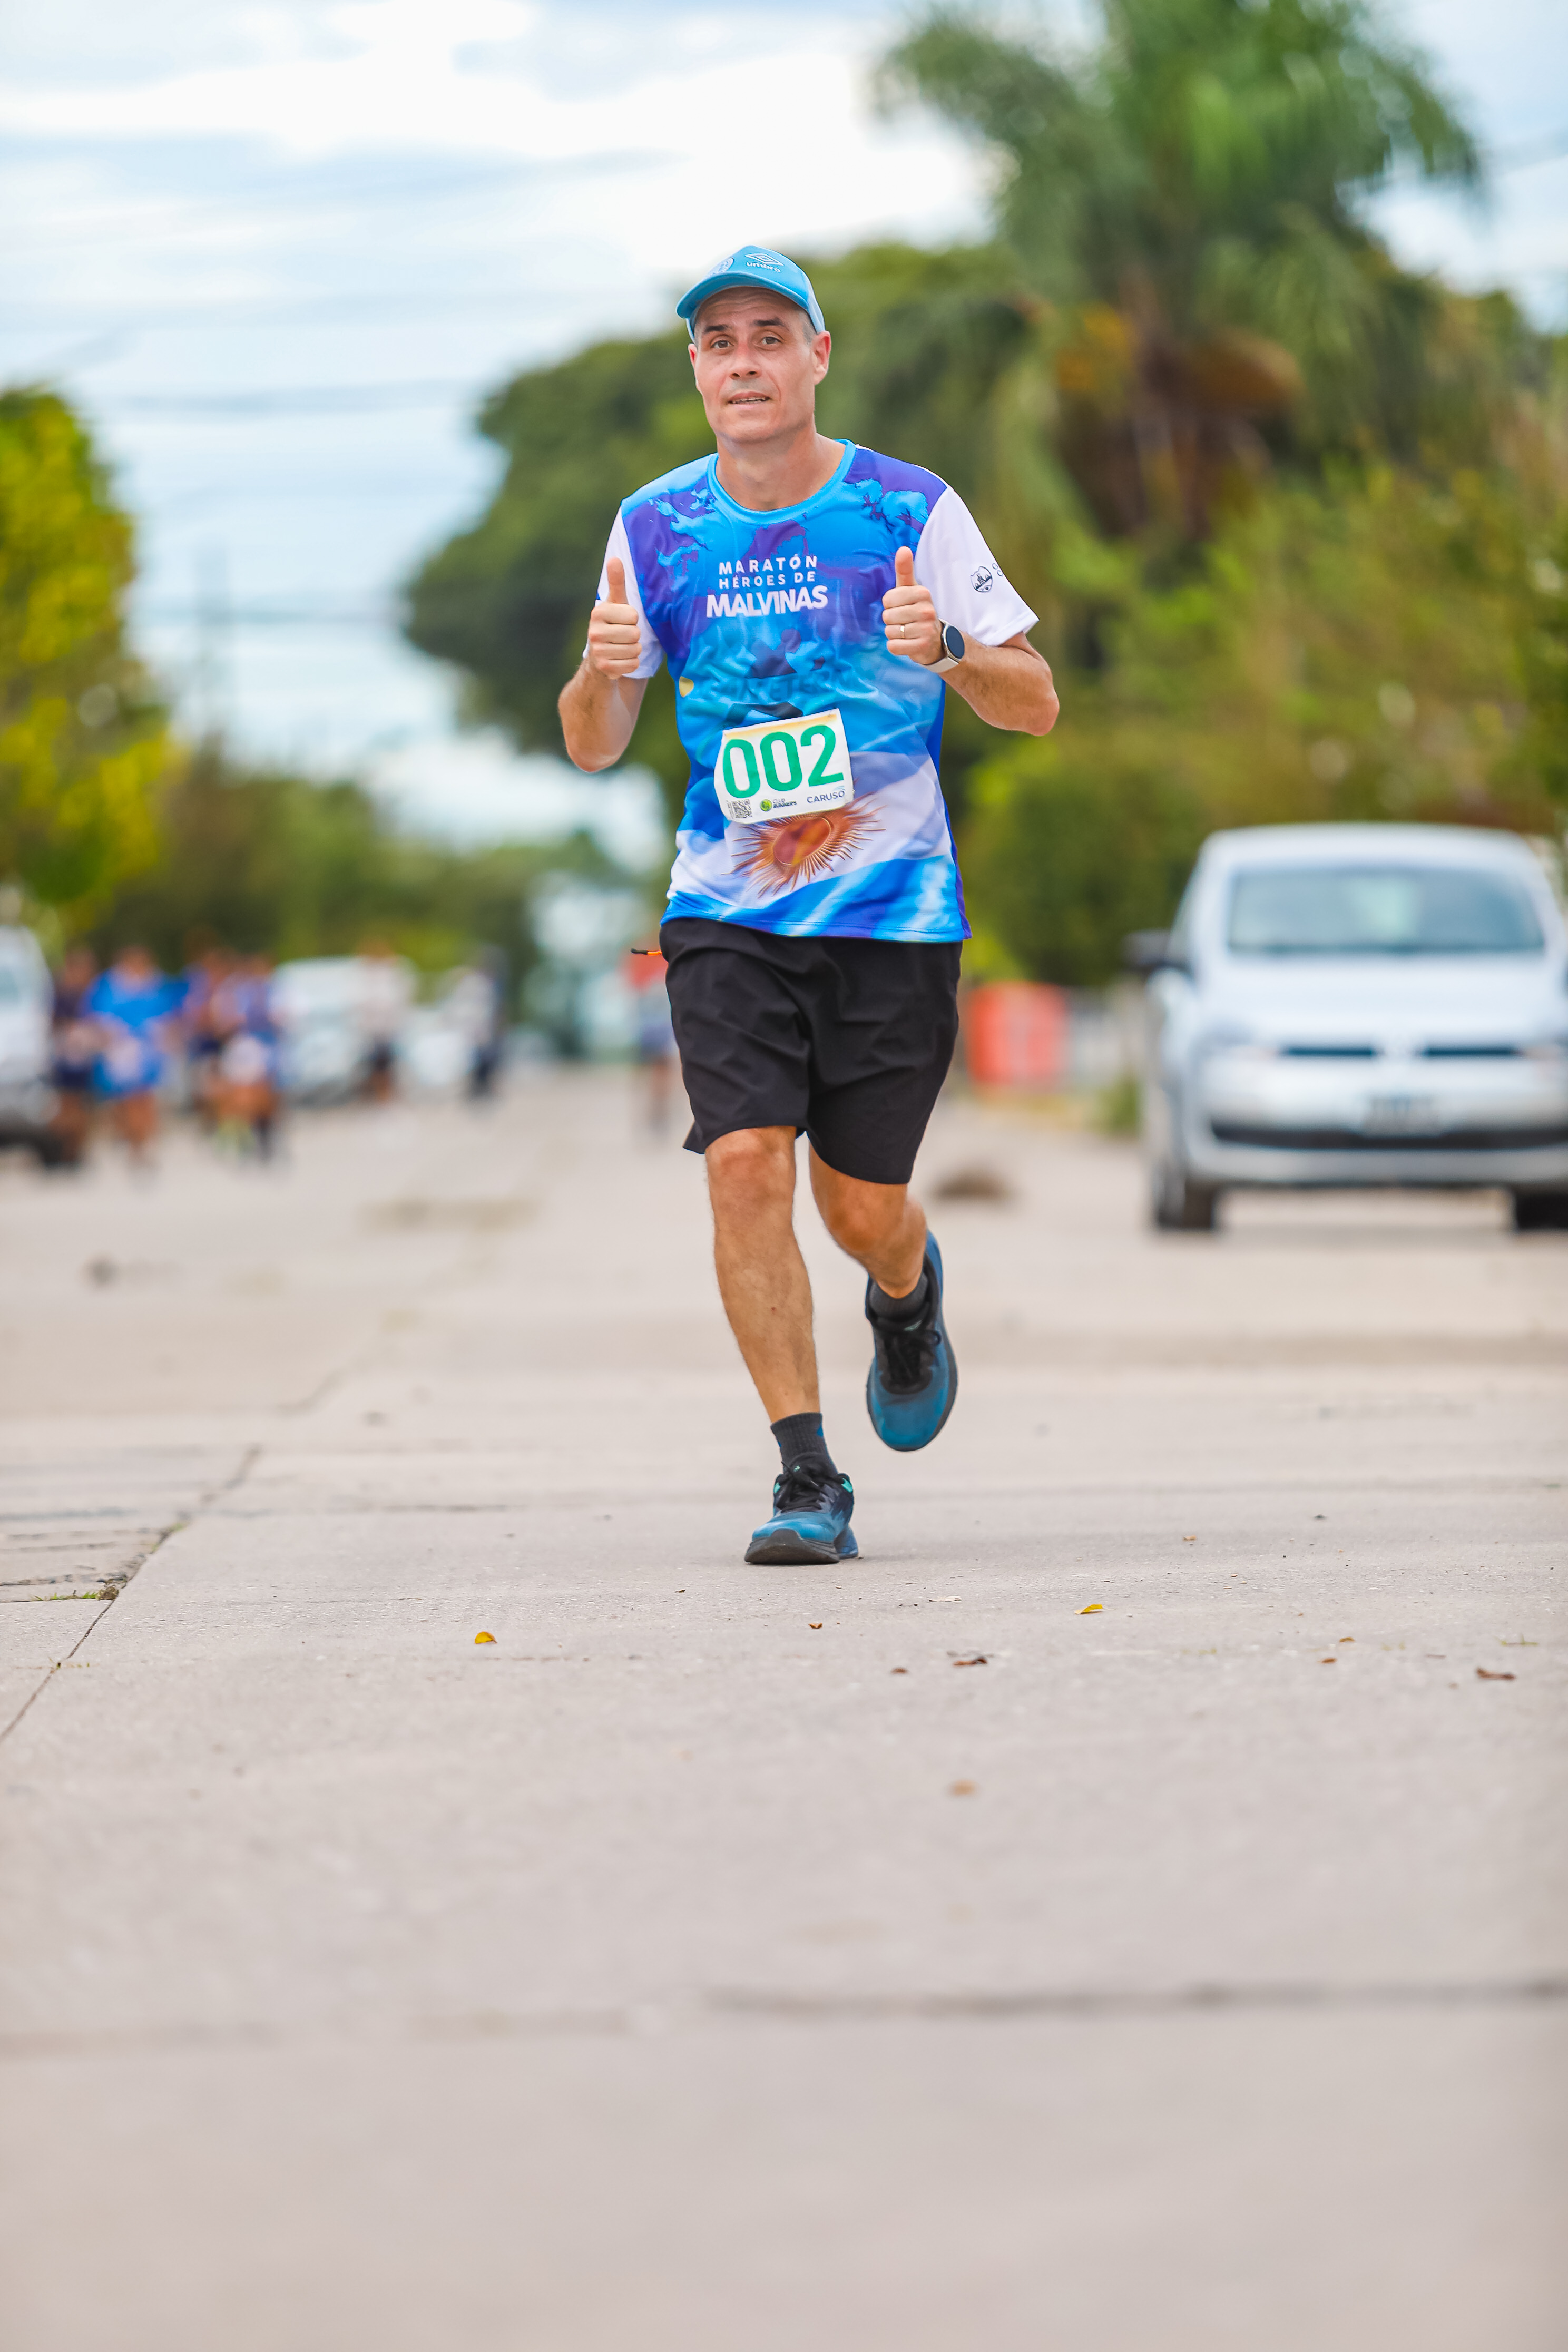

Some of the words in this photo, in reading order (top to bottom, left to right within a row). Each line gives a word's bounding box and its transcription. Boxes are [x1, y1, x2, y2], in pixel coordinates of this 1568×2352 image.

[746, 262, 781, 272] umbro
[719, 554, 817, 575] MARATÓN
[719, 574, 786, 589] HÉROES
[794, 571, 816, 583] DE
[706, 585, 828, 618] MALVINAS
[722, 724, 844, 799] 002
[807, 790, 845, 803] CARUSO
